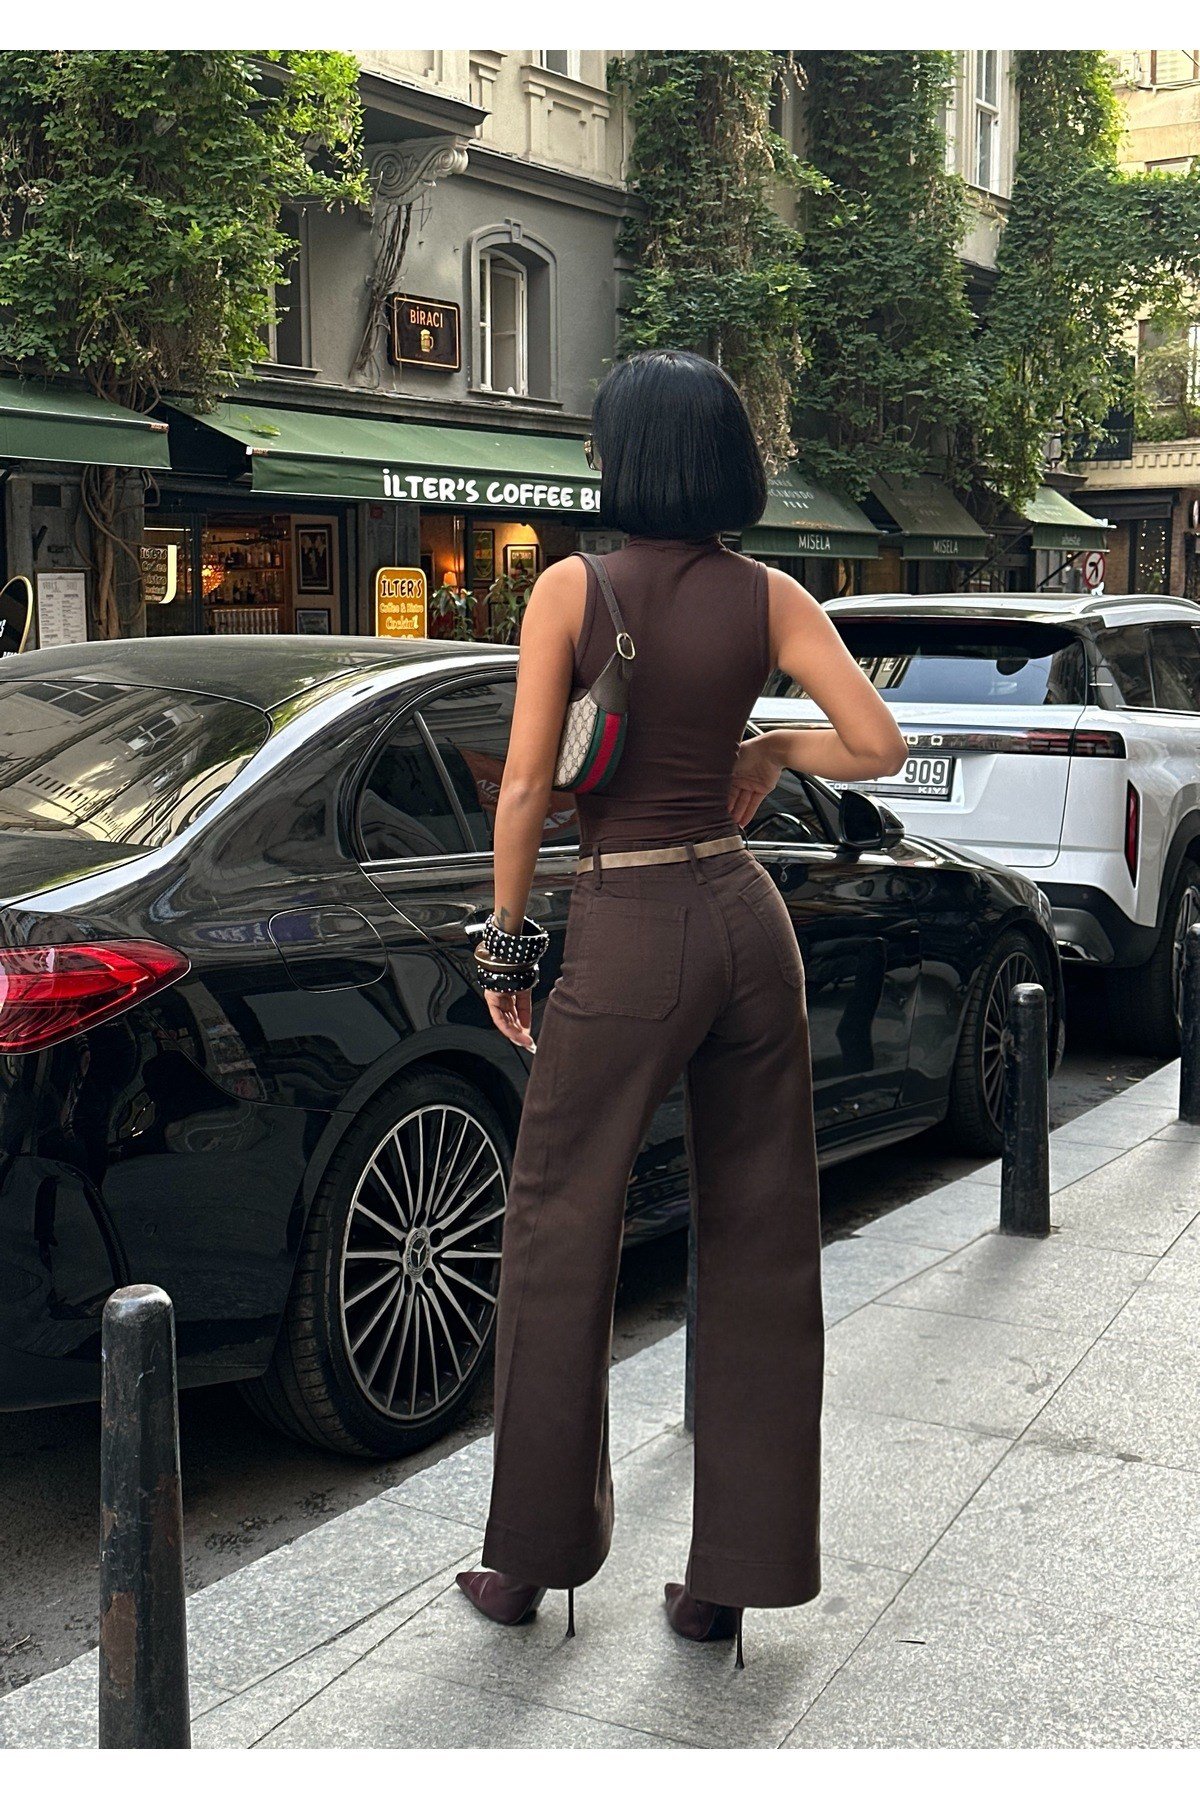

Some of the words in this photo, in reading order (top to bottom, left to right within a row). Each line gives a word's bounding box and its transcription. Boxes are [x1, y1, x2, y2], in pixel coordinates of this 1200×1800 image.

[486, 481, 574, 508] COFFEE
[798, 535, 831, 551] MISELA
[932, 540, 959, 554] MISELA
[904, 759, 946, 785] 909
